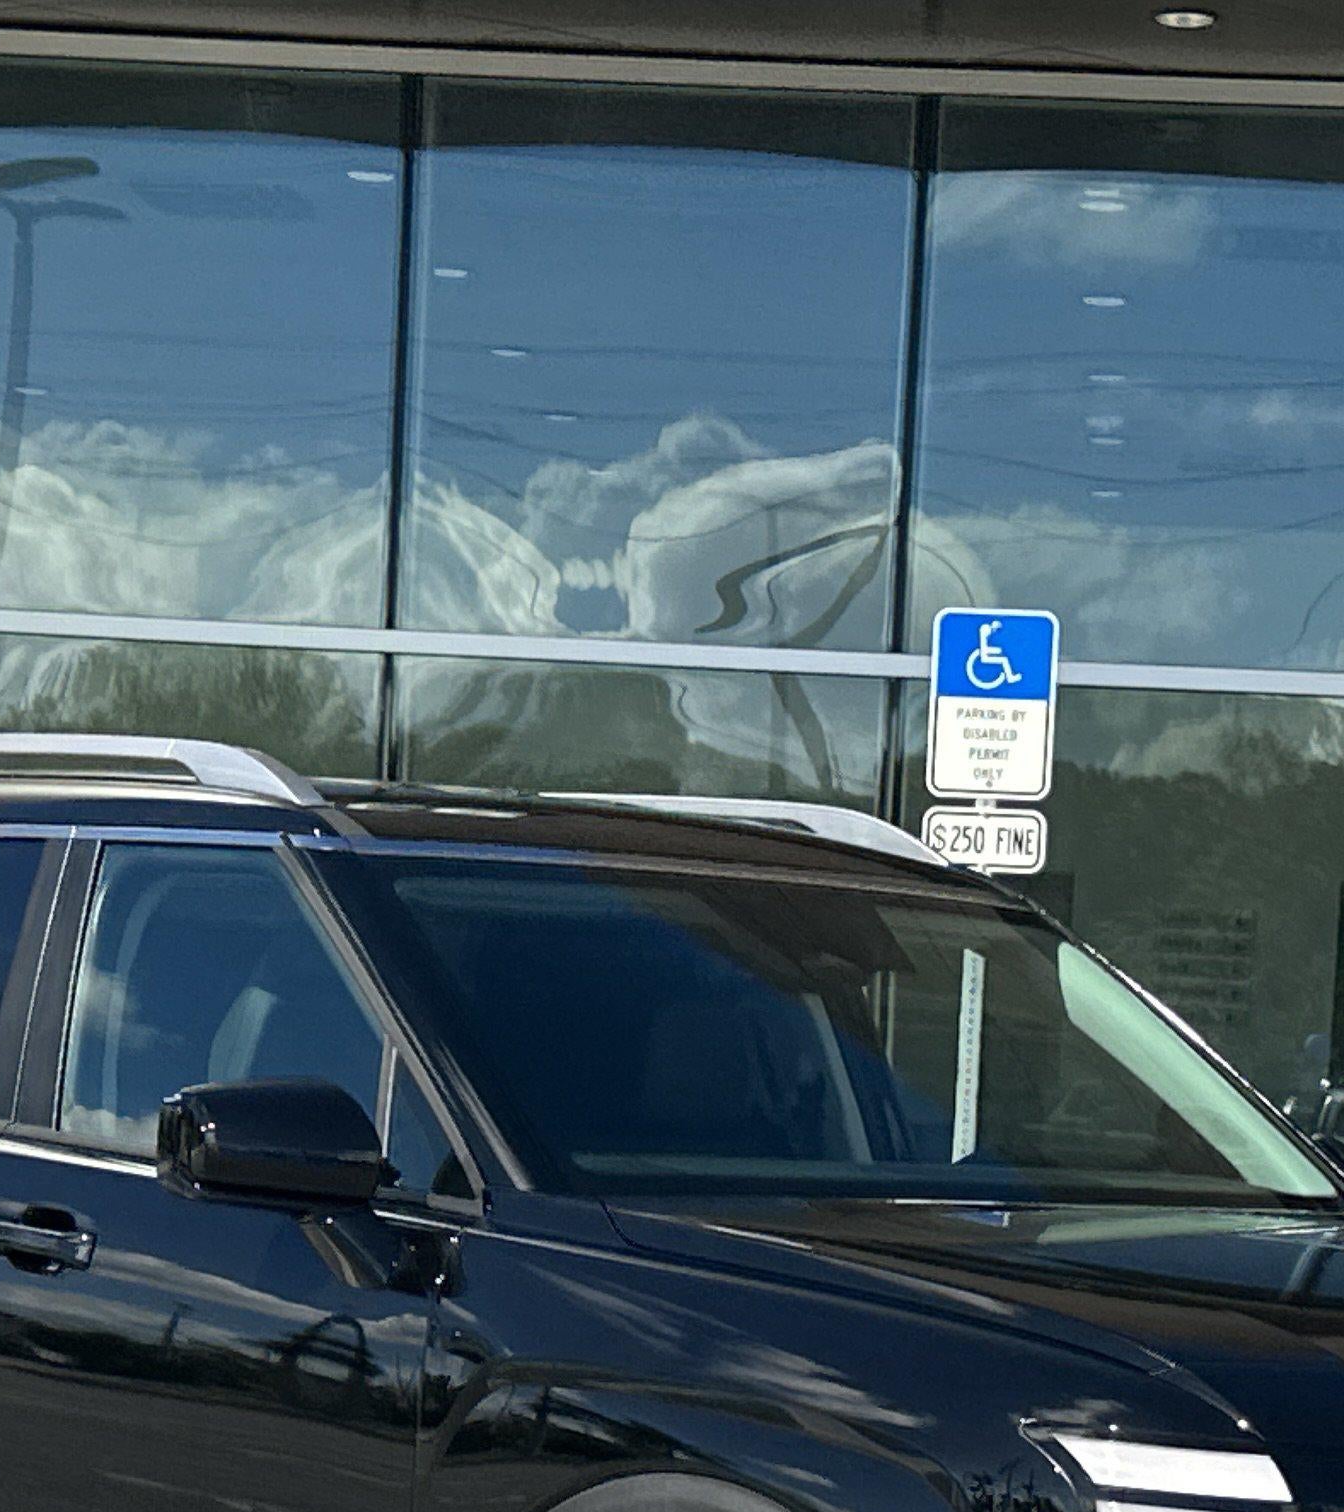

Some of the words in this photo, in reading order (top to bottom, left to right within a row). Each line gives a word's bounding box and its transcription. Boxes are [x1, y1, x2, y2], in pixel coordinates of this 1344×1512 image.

[957, 708, 1005, 721] PARKING
[1012, 709, 1026, 722] BY
[963, 727, 1017, 741] DISABLED
[968, 747, 1010, 760] PERMIT
[973, 767, 1003, 780] ONLY
[932, 823, 985, 854] $250
[996, 827, 1036, 856] FINE
